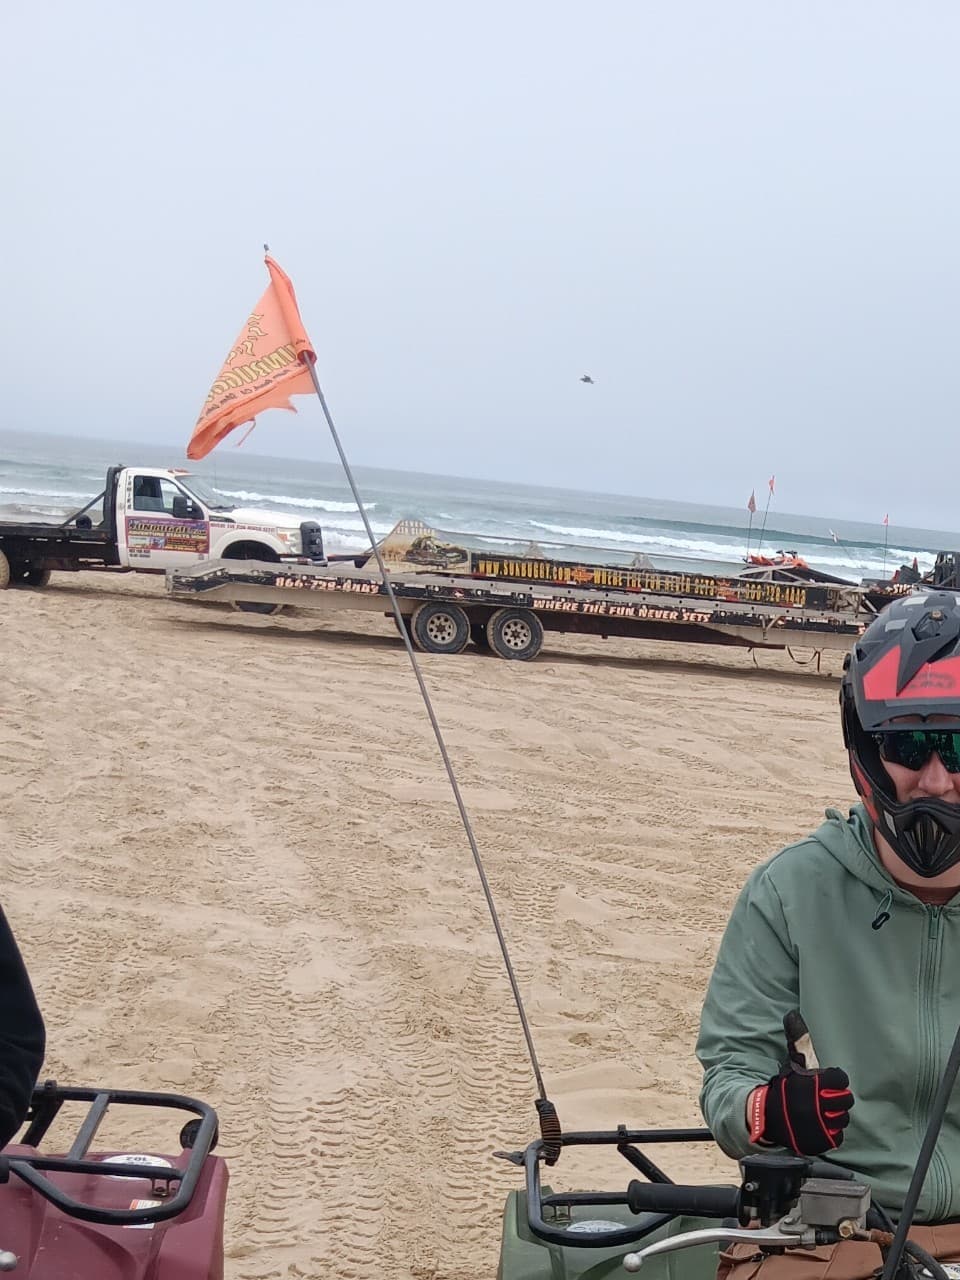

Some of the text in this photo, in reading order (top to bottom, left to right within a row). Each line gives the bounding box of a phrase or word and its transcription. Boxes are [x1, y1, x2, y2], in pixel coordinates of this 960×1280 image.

[532, 599, 711, 623] WHERE THE FUN NEVER SETS
